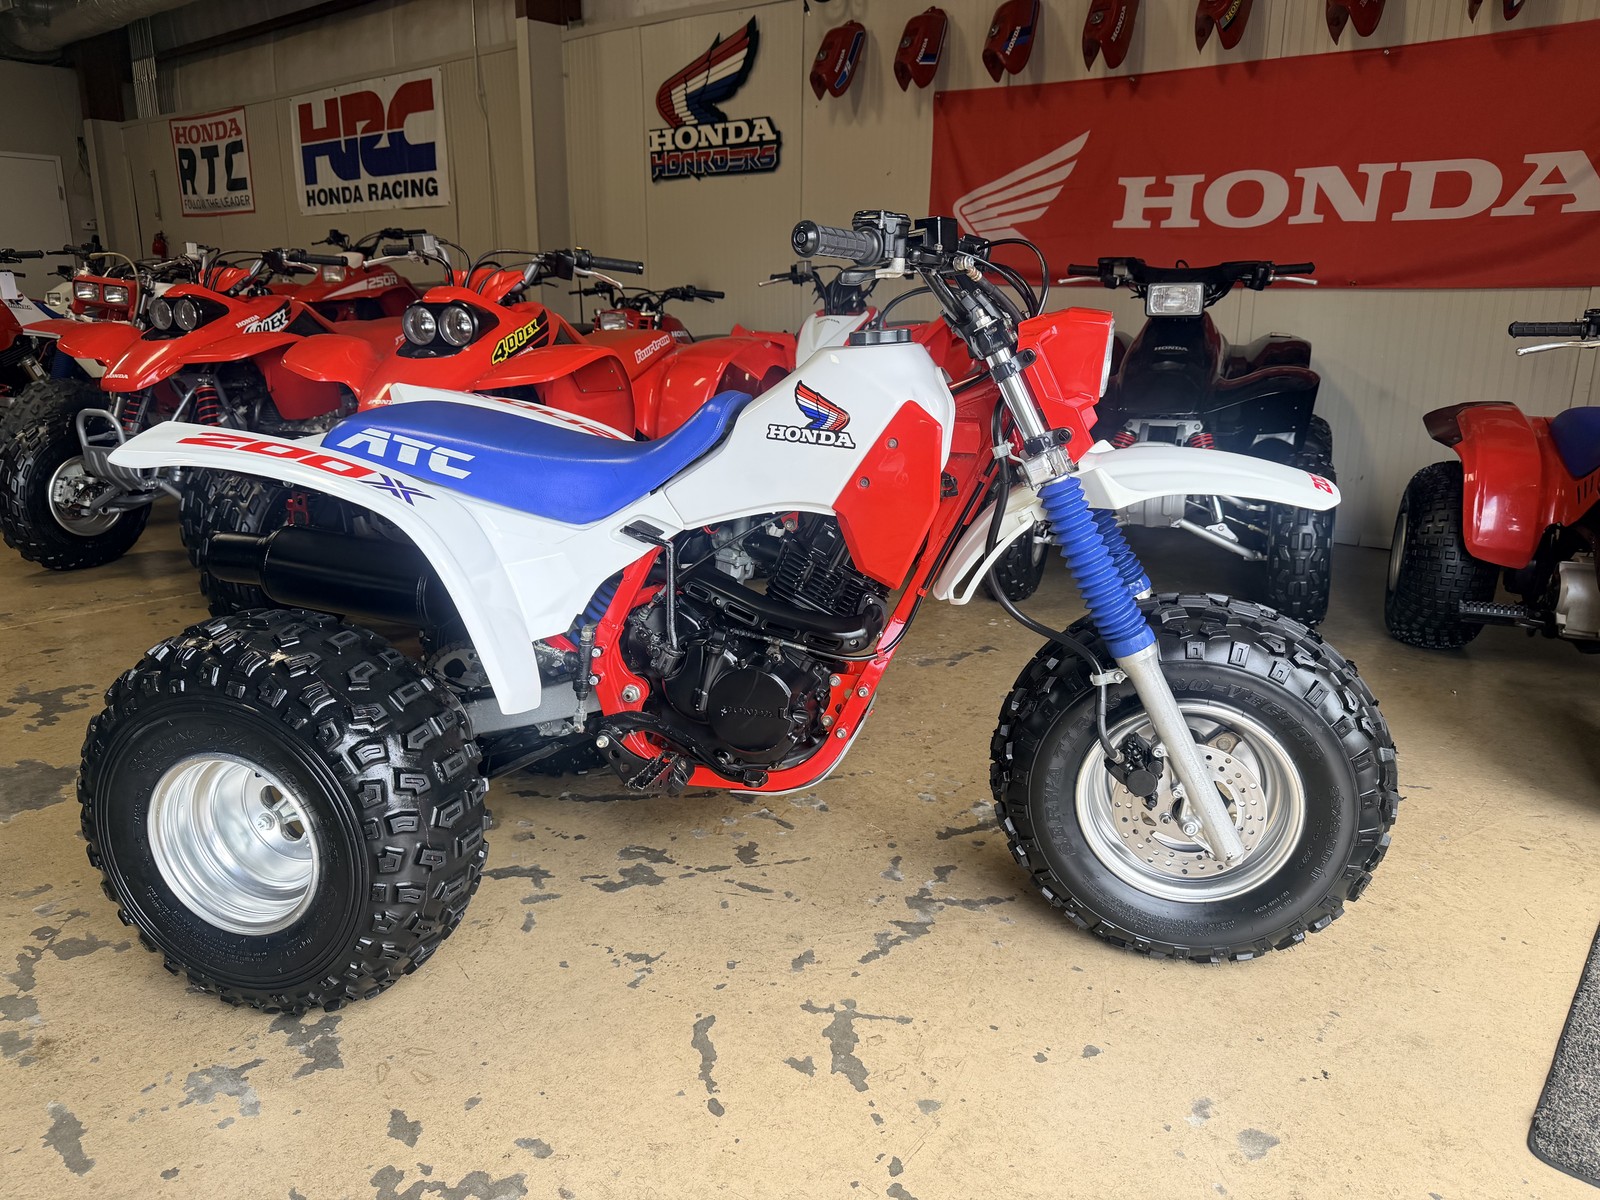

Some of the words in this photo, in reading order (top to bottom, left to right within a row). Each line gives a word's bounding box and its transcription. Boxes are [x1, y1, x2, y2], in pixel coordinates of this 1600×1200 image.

[1111, 5, 1127, 42] HONDA
[916, 38, 929, 63] HONDA
[1005, 25, 1021, 56] HONDA
[174, 117, 242, 144] HONDA
[298, 78, 437, 186] HRC
[648, 118, 777, 151] HONDA
[178, 139, 248, 195] RTC
[207, 198, 221, 208] THE
[220, 195, 251, 208] LEADER
[306, 185, 363, 207] HONDA
[367, 177, 439, 201] RACING
[1112, 148, 1600, 230] HONDA
[235, 314, 260, 328] HONDA
[491, 318, 540, 365] 400EX
[766, 423, 856, 449] HONDA
[176, 432, 437, 507] 200X
[337, 427, 476, 480] ATC
